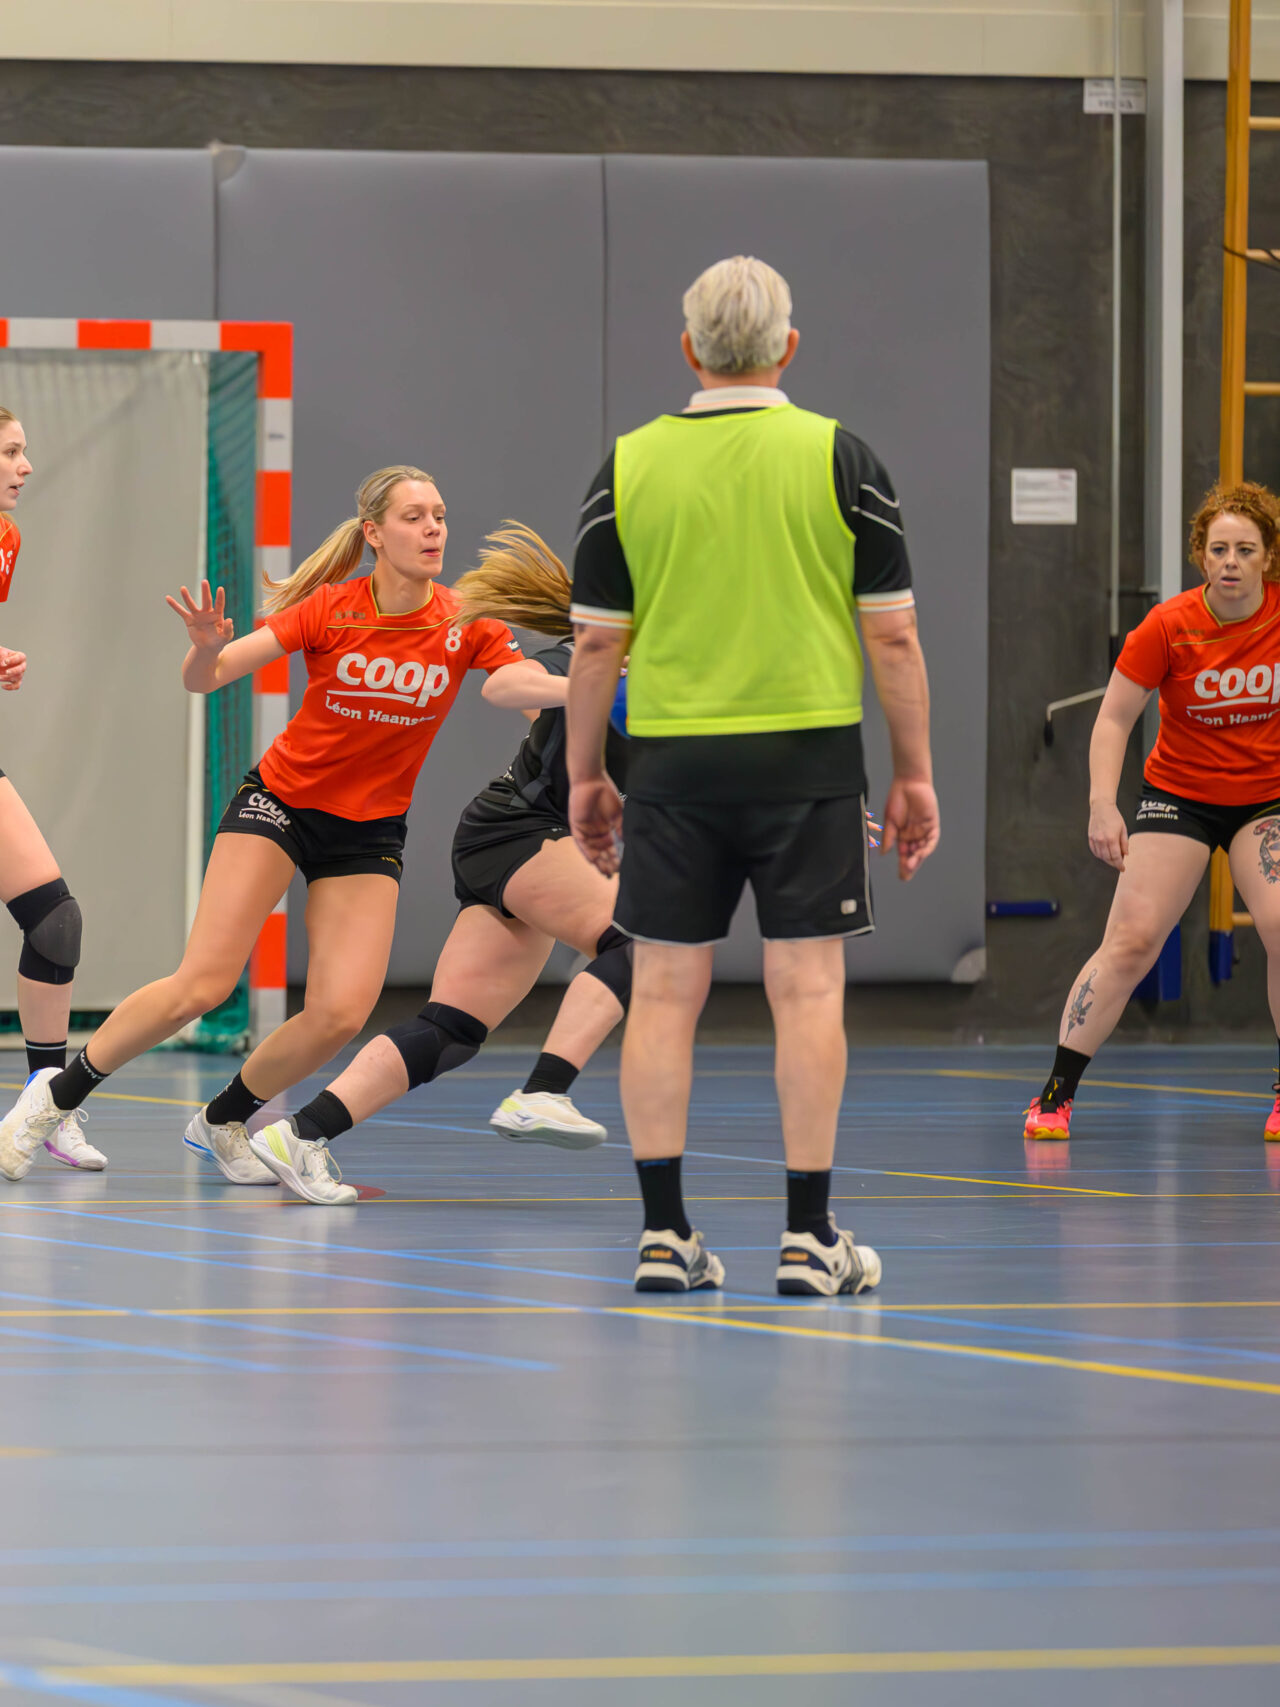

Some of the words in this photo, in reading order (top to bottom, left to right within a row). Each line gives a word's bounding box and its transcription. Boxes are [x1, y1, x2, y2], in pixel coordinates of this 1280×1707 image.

[445, 627, 462, 652] 8
[336, 652, 450, 708] coop
[325, 695, 362, 720] Léon
[368, 709, 436, 726] Haans
